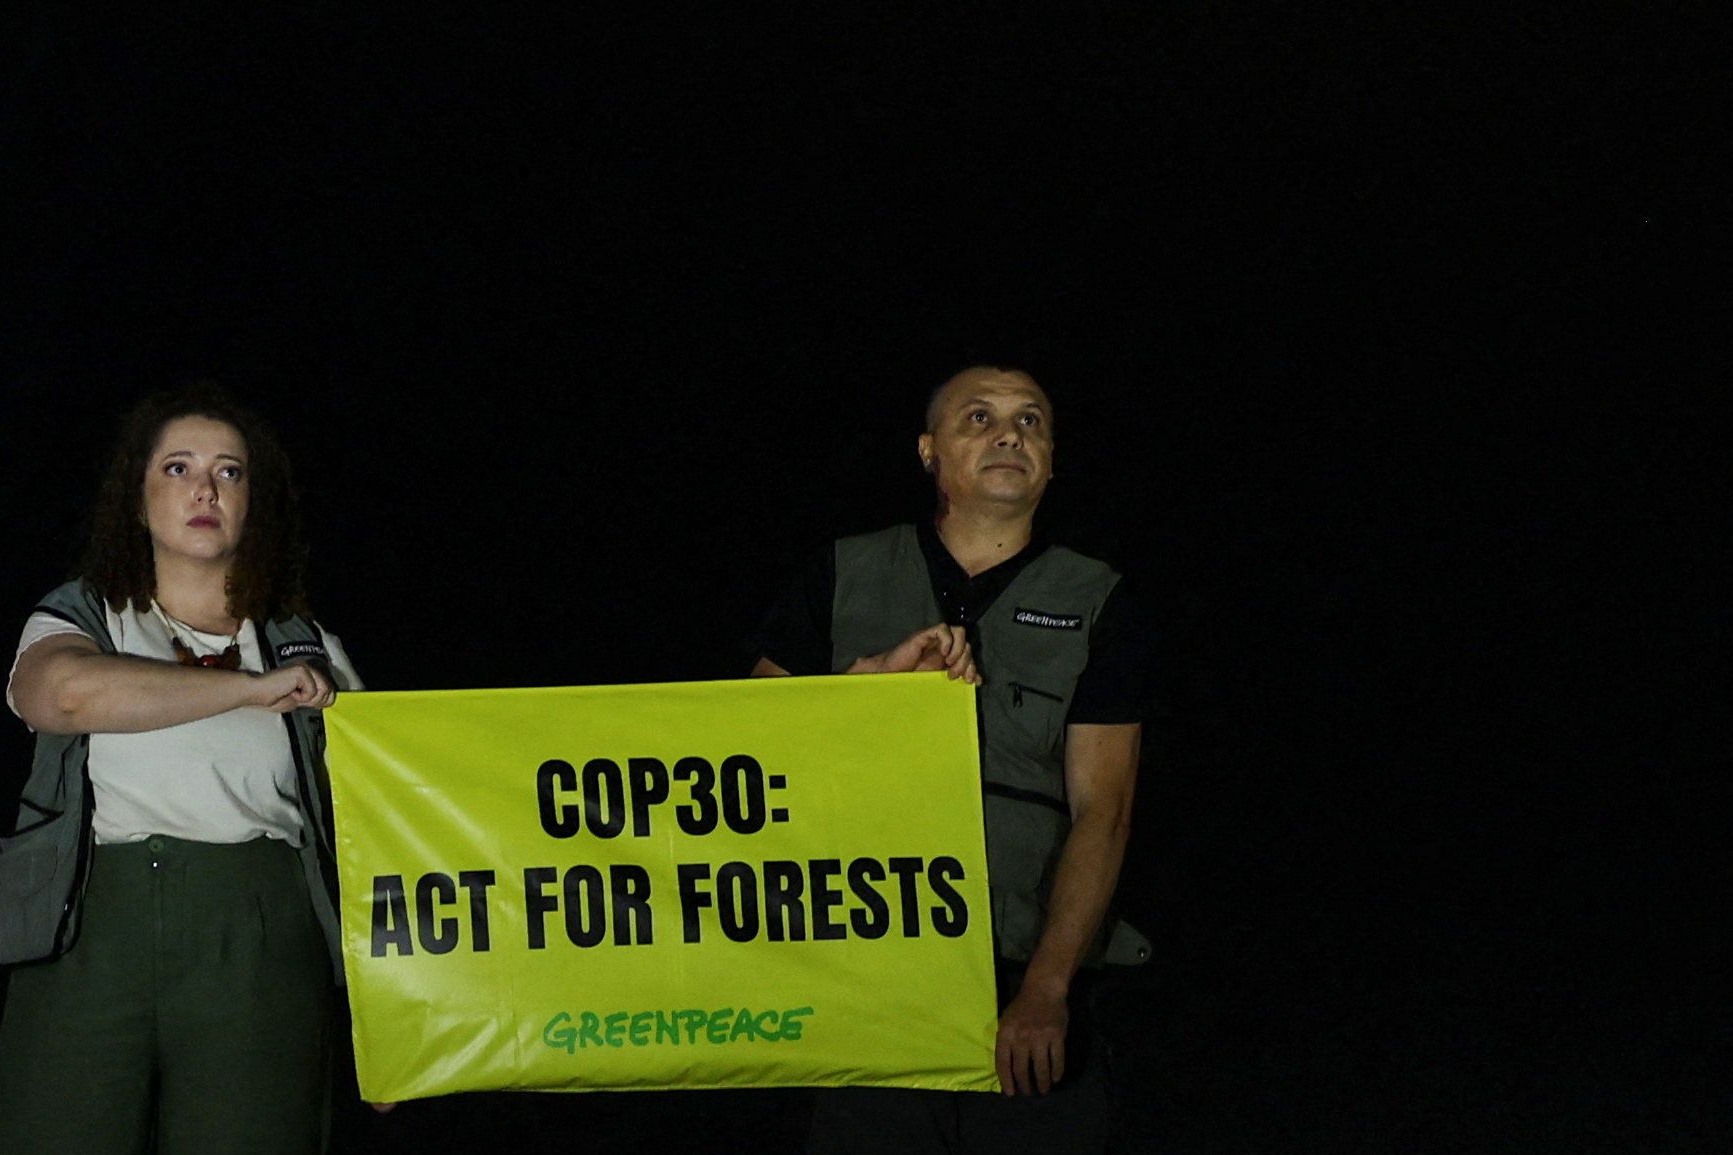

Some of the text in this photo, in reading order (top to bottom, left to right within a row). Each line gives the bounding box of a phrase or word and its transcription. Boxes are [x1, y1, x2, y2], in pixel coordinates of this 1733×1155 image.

[536, 754, 789, 840] COP30:
[370, 856, 968, 959] ACT FOR FORESTS
[543, 1007, 814, 1055] GREENPEACE
